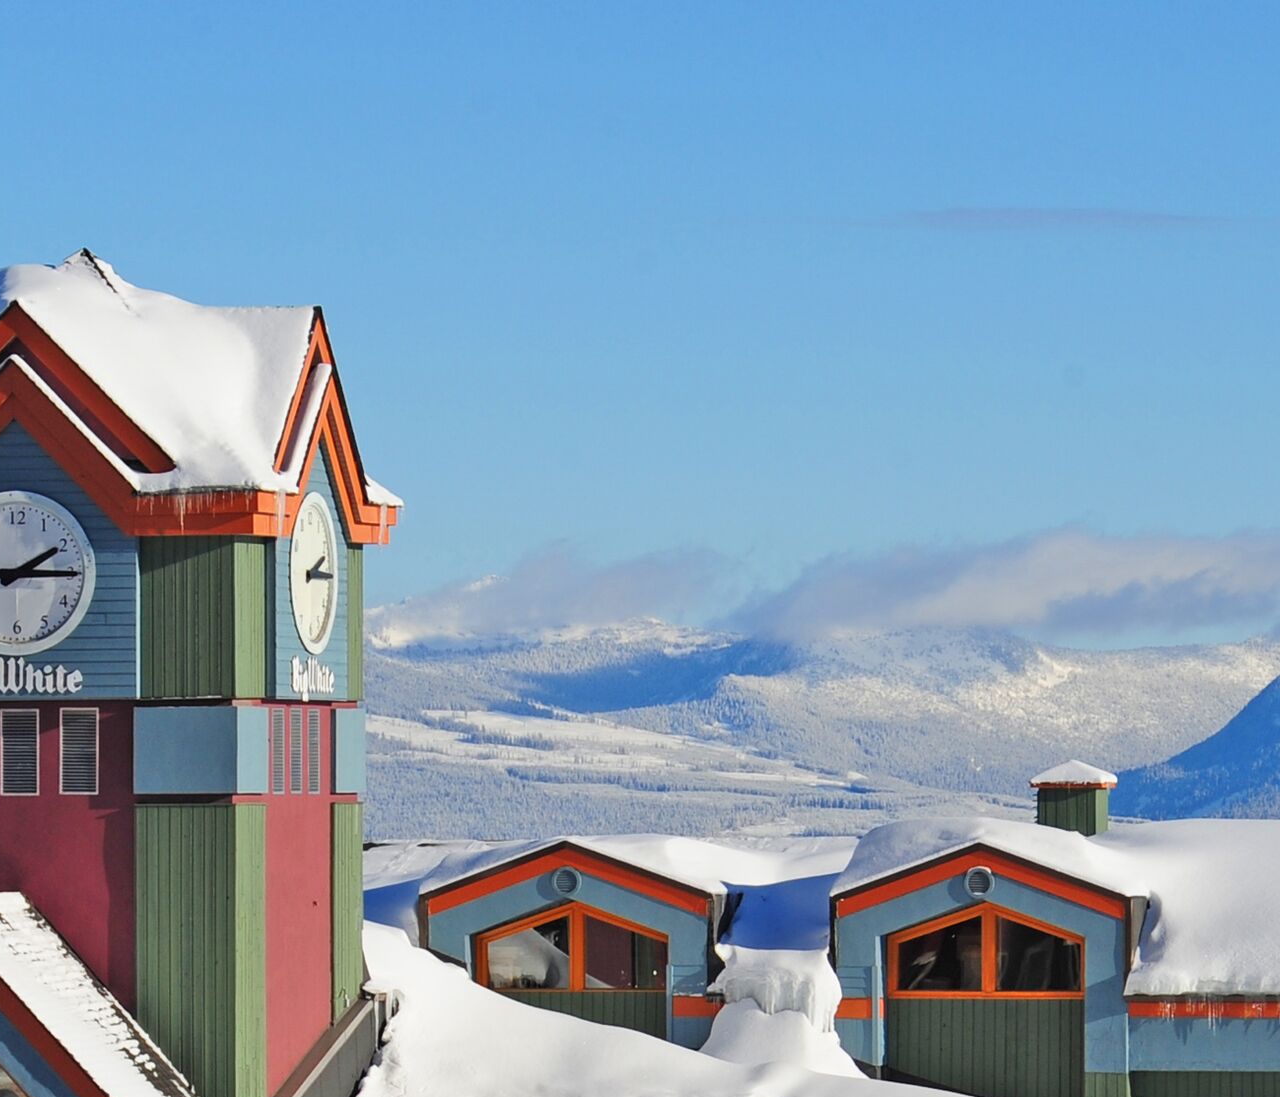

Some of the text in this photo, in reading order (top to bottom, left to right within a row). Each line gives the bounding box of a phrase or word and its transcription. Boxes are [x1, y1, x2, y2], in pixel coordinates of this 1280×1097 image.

[9, 510, 26, 525] 12
[40, 518, 47, 532] 1
[58, 538, 68, 552] 2
[58, 594, 68, 609] 4
[13, 620, 22, 634] 6
[39, 615, 49, 629] 5
